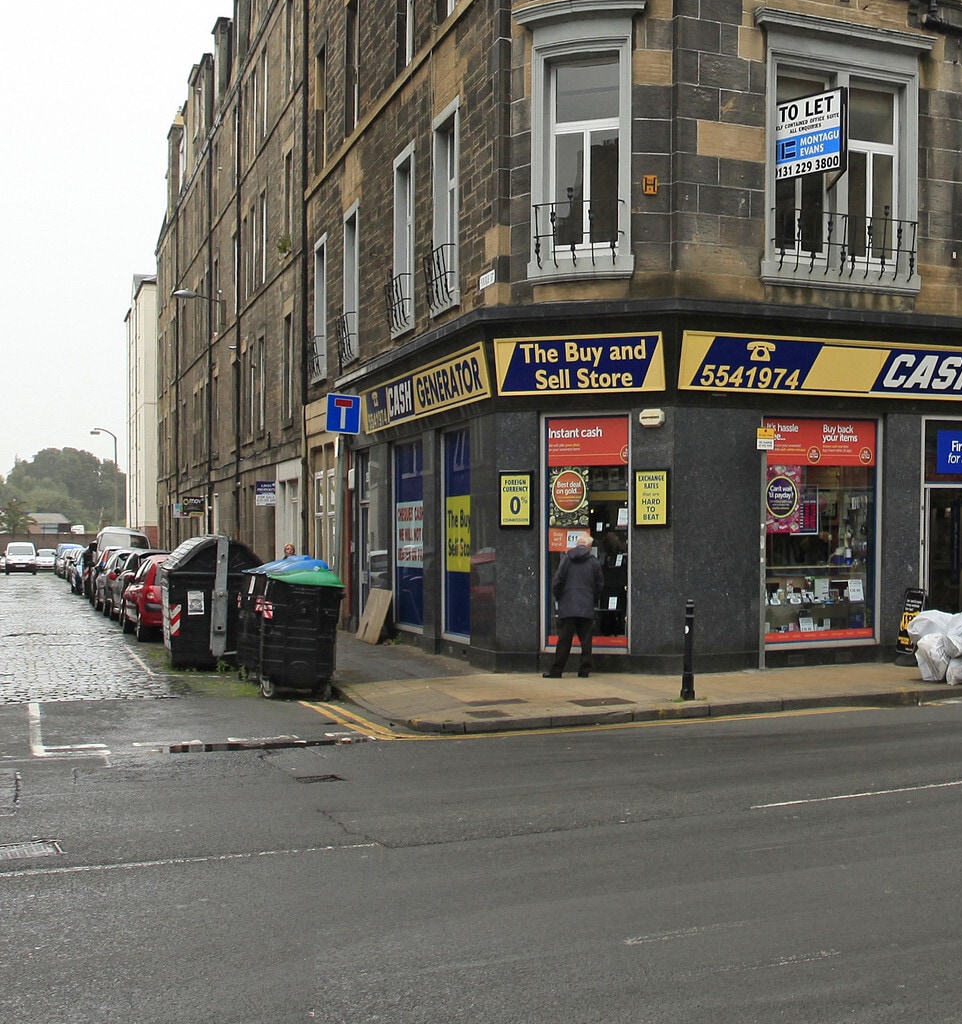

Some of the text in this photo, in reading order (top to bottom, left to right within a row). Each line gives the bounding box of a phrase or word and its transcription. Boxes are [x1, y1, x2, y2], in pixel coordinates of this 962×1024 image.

[779, 95, 834, 123] TO LET
[800, 129, 840, 146] MONTAGU
[800, 143, 824, 157] EVANS
[795, 161, 813, 174] 229
[815, 155, 839, 170] 3800
[644, 177, 656, 192] H
[520, 339, 647, 367] The Buy and
[535, 367, 634, 389] Sell Store
[700, 364, 801, 389] 5541974
[388, 356, 483, 417] CASH GENERATOR
[548, 426, 603, 439] Instant cash
[777, 423, 799, 433] hassle
[822, 424, 854, 434] Buy back
[822, 433, 858, 444] your items
[948, 453, 961, 465] for
[502, 486, 528, 494] CURRENCY
[556, 480, 569, 488] Best
[448, 510, 458, 528] The
[448, 538, 459, 556] Sell
